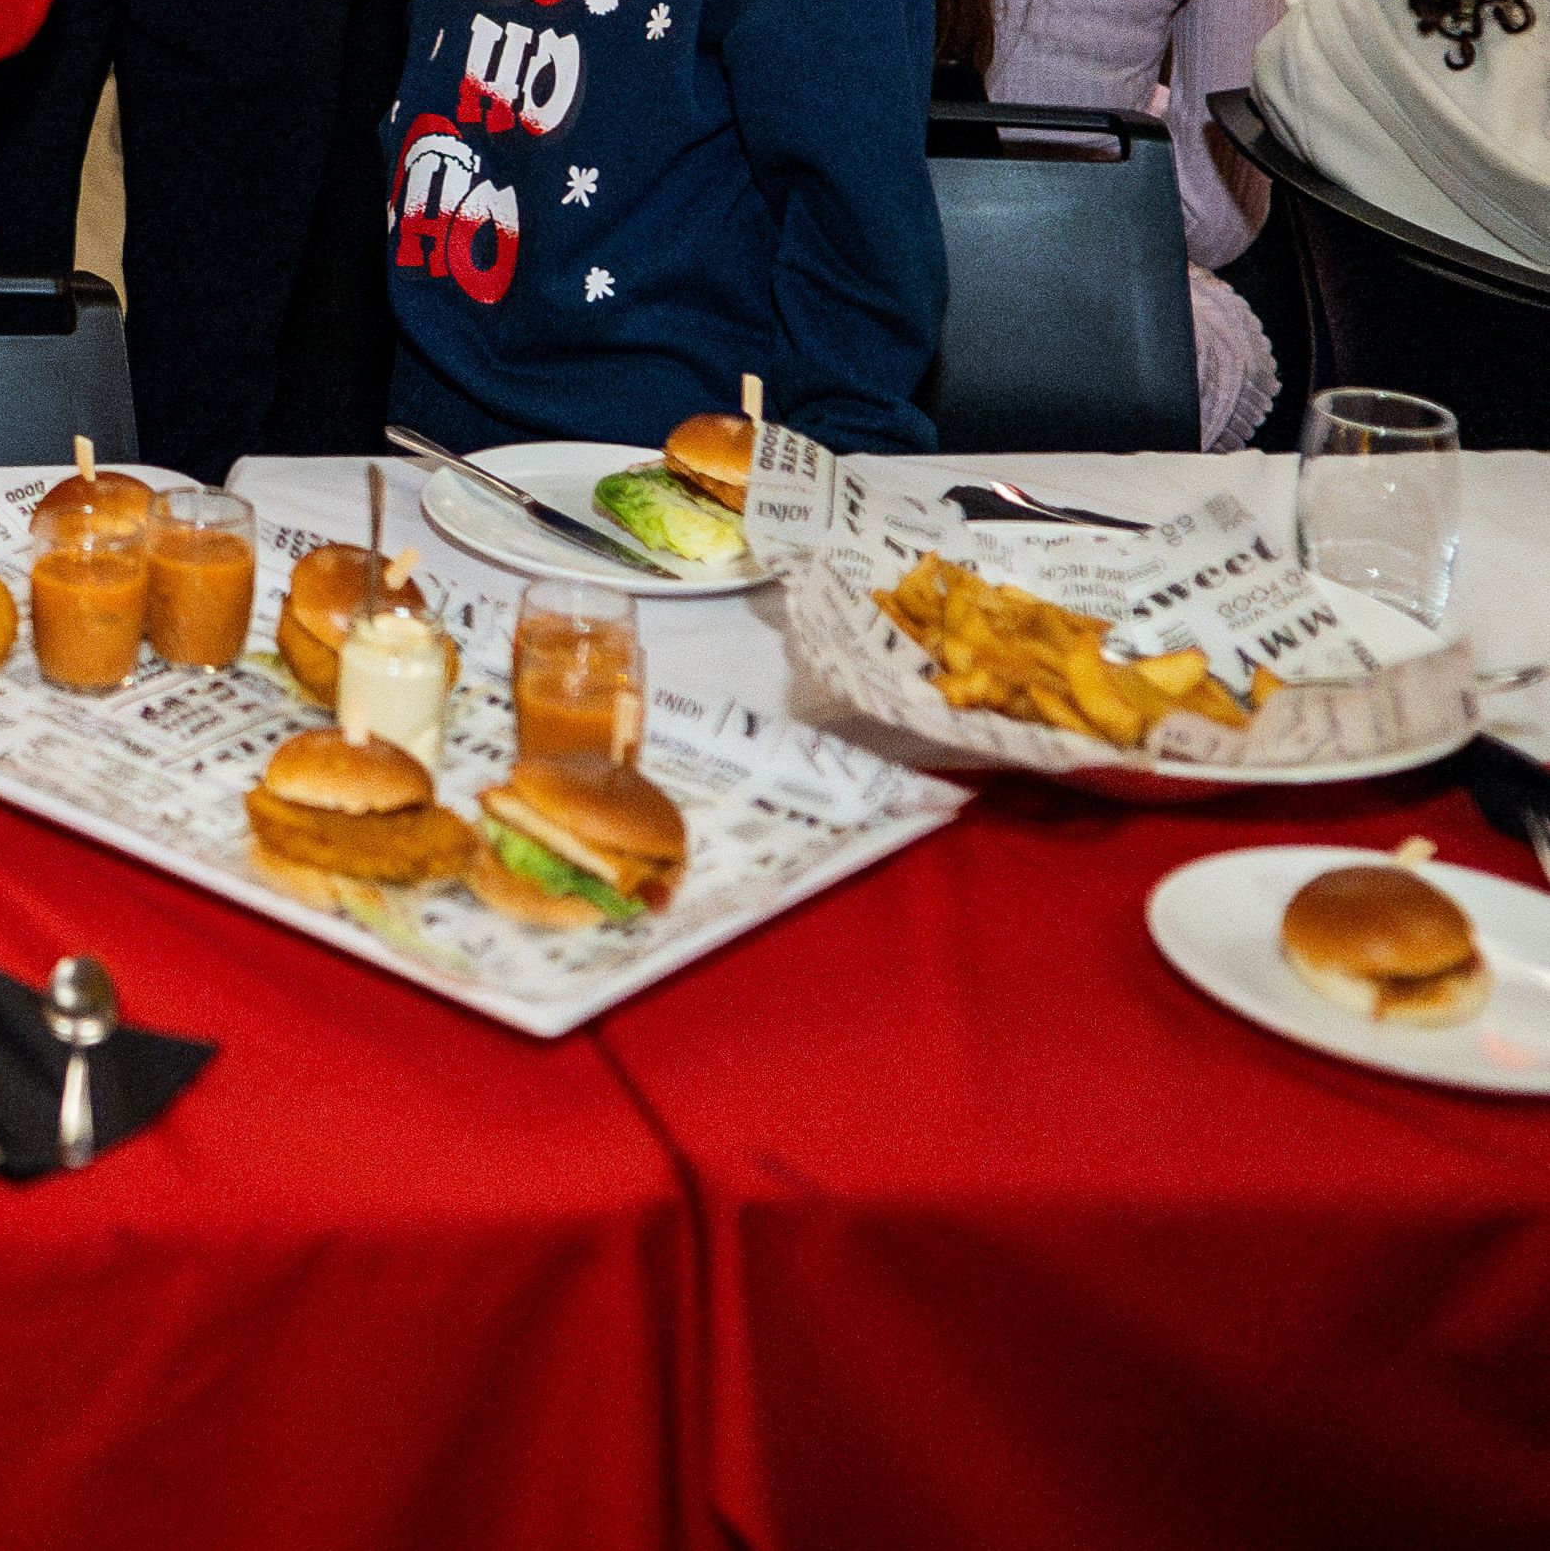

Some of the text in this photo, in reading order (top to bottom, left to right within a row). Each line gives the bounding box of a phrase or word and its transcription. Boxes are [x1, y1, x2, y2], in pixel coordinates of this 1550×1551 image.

[456, 13, 581, 136] HO
[396, 152, 520, 304] HO
[757, 500, 813, 522] ENJOY
